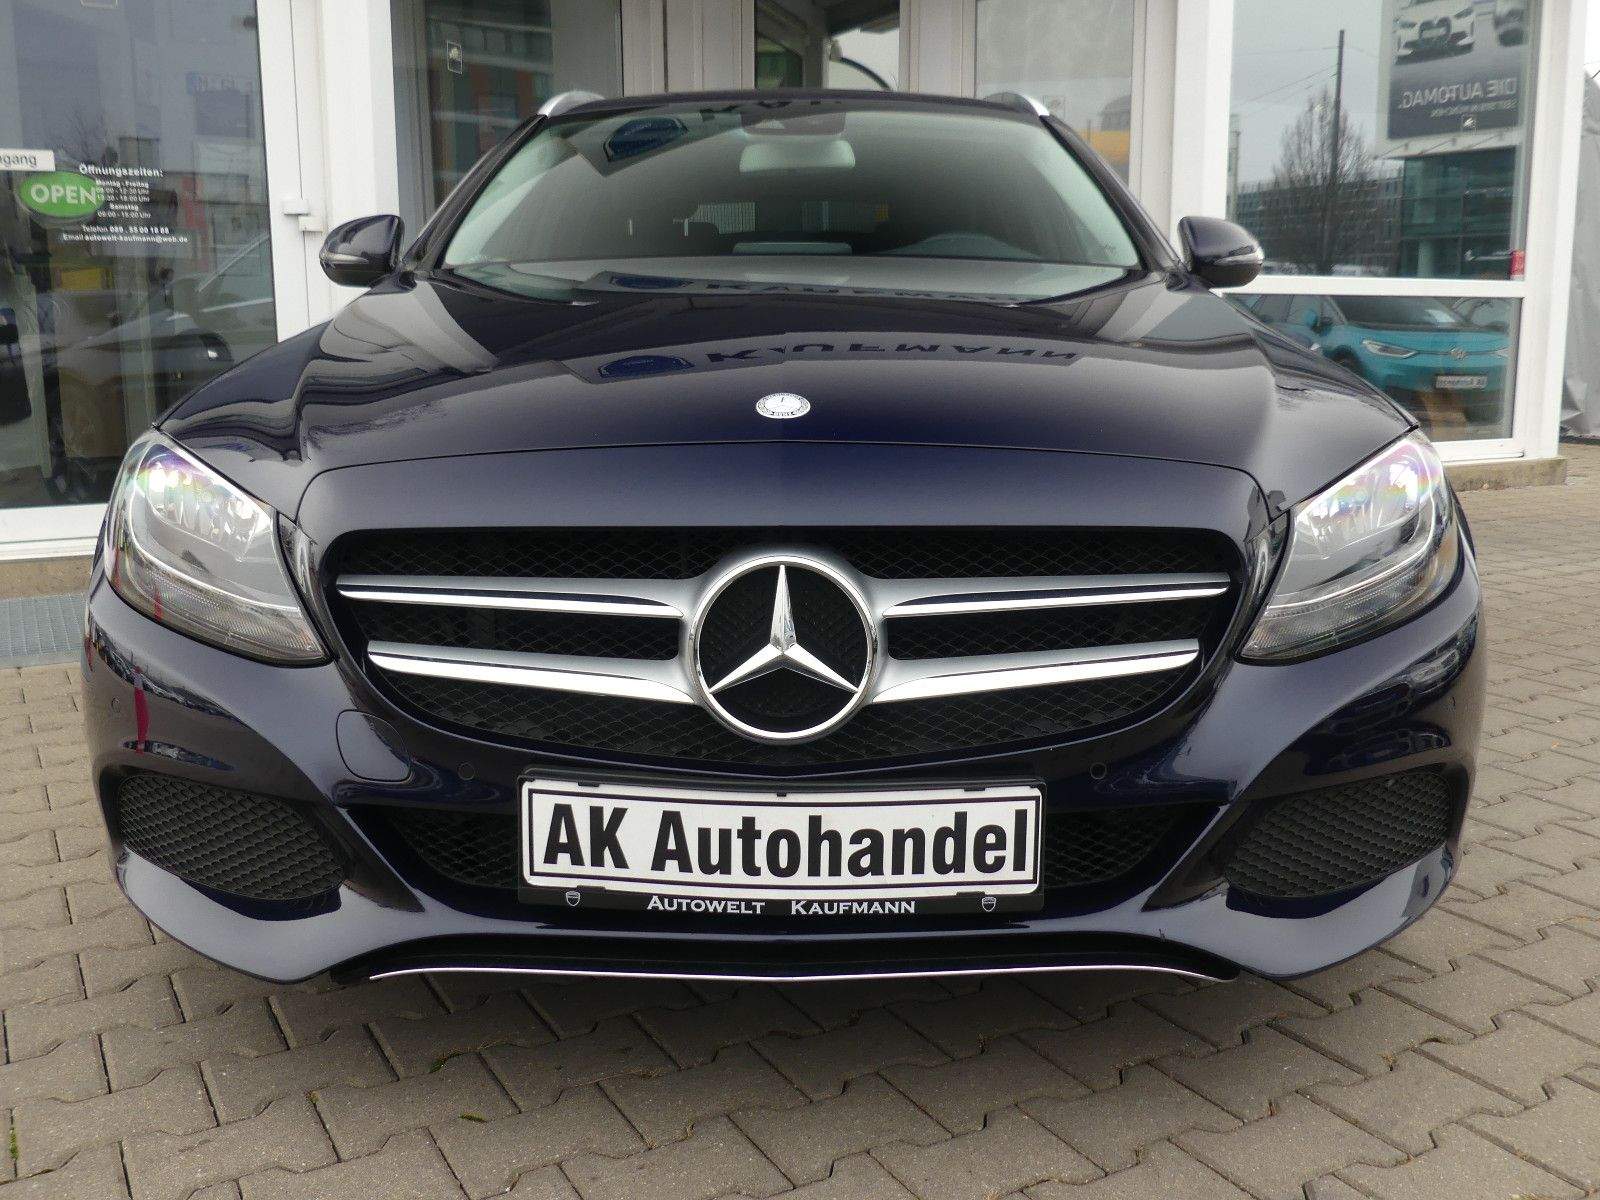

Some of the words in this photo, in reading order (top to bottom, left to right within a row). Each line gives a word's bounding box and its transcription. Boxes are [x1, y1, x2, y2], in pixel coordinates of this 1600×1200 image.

[0, 152, 37, 169] gang
[79, 162, 164, 178] Öffnungszeiten:
[30, 184, 99, 207] OPEN
[543, 803, 630, 870] AK
[650, 808, 1028, 878] Autohandel
